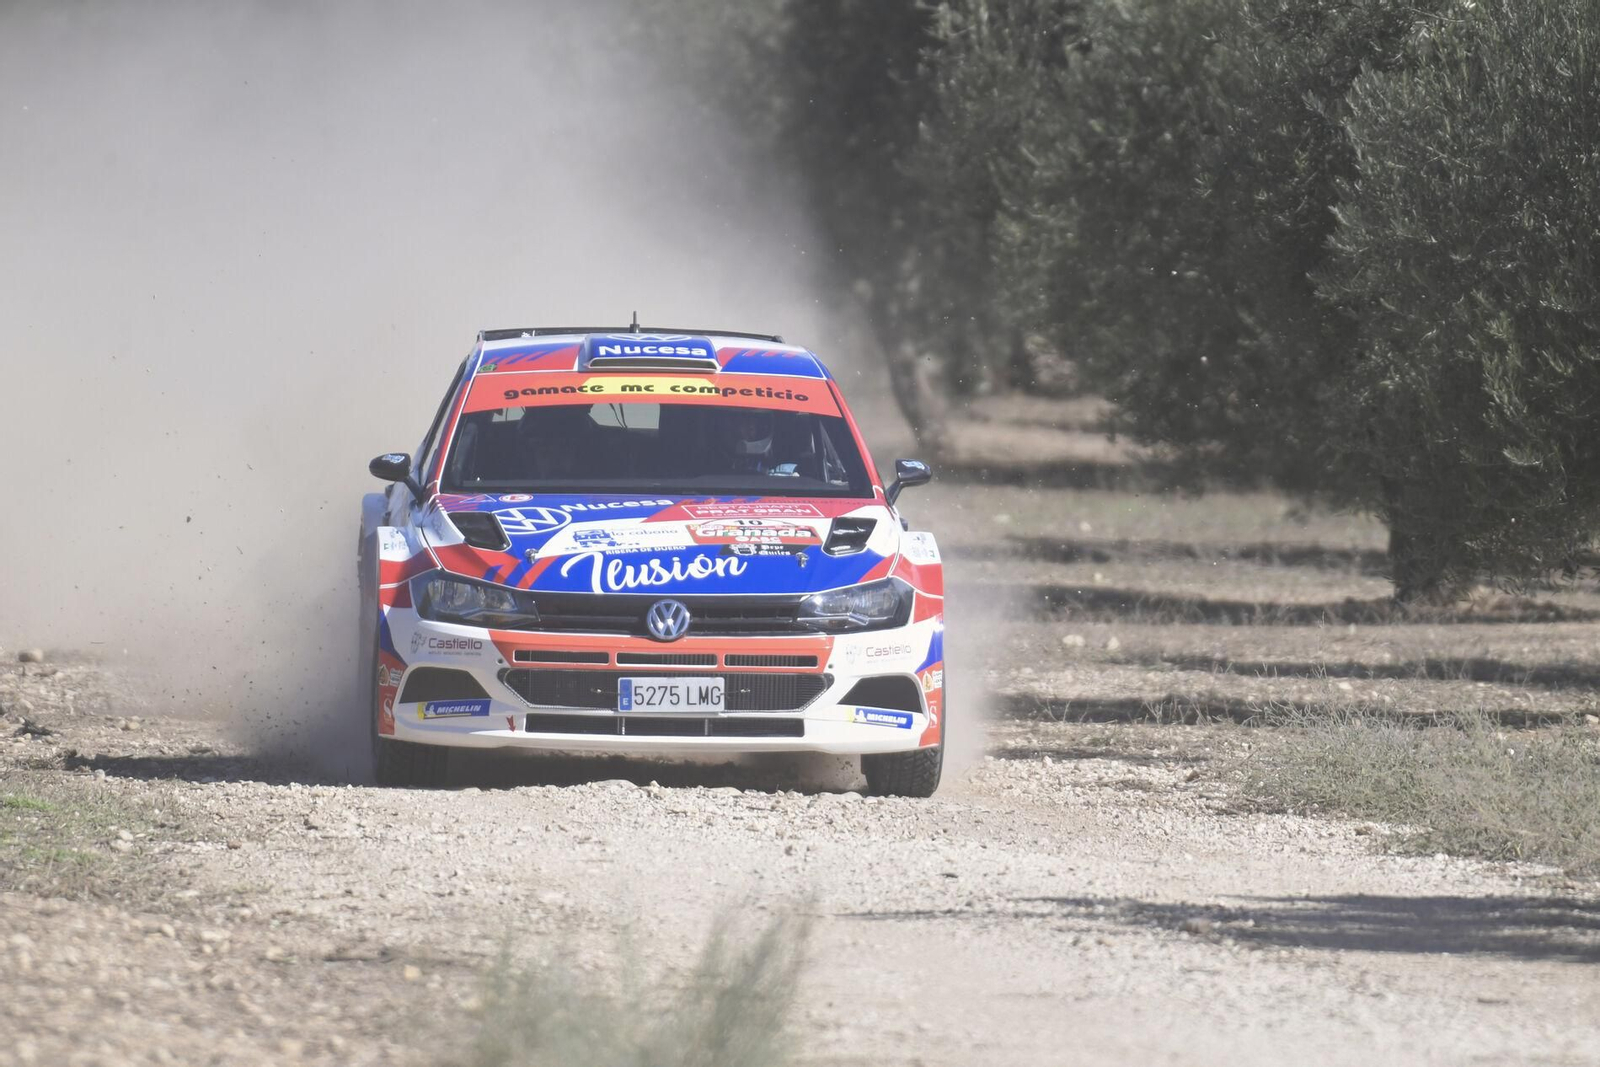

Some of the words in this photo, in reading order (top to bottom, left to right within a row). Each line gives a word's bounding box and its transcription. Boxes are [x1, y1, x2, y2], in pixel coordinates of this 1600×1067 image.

[597, 344, 708, 357] Nucesa
[504, 384, 604, 399] gamace
[620, 384, 657, 393] mc
[669, 384, 809, 402] competicio
[560, 499, 675, 513] Nucesa
[695, 528, 812, 537] Granada
[428, 638, 483, 650] Castiello
[865, 644, 912, 658] Castiello
[622, 698, 629, 706] E
[634, 686, 680, 706] 5275
[686, 686, 721, 706] LMG
[436, 704, 482, 714] MICHELIN
[866, 713, 908, 725] MICHELIN
